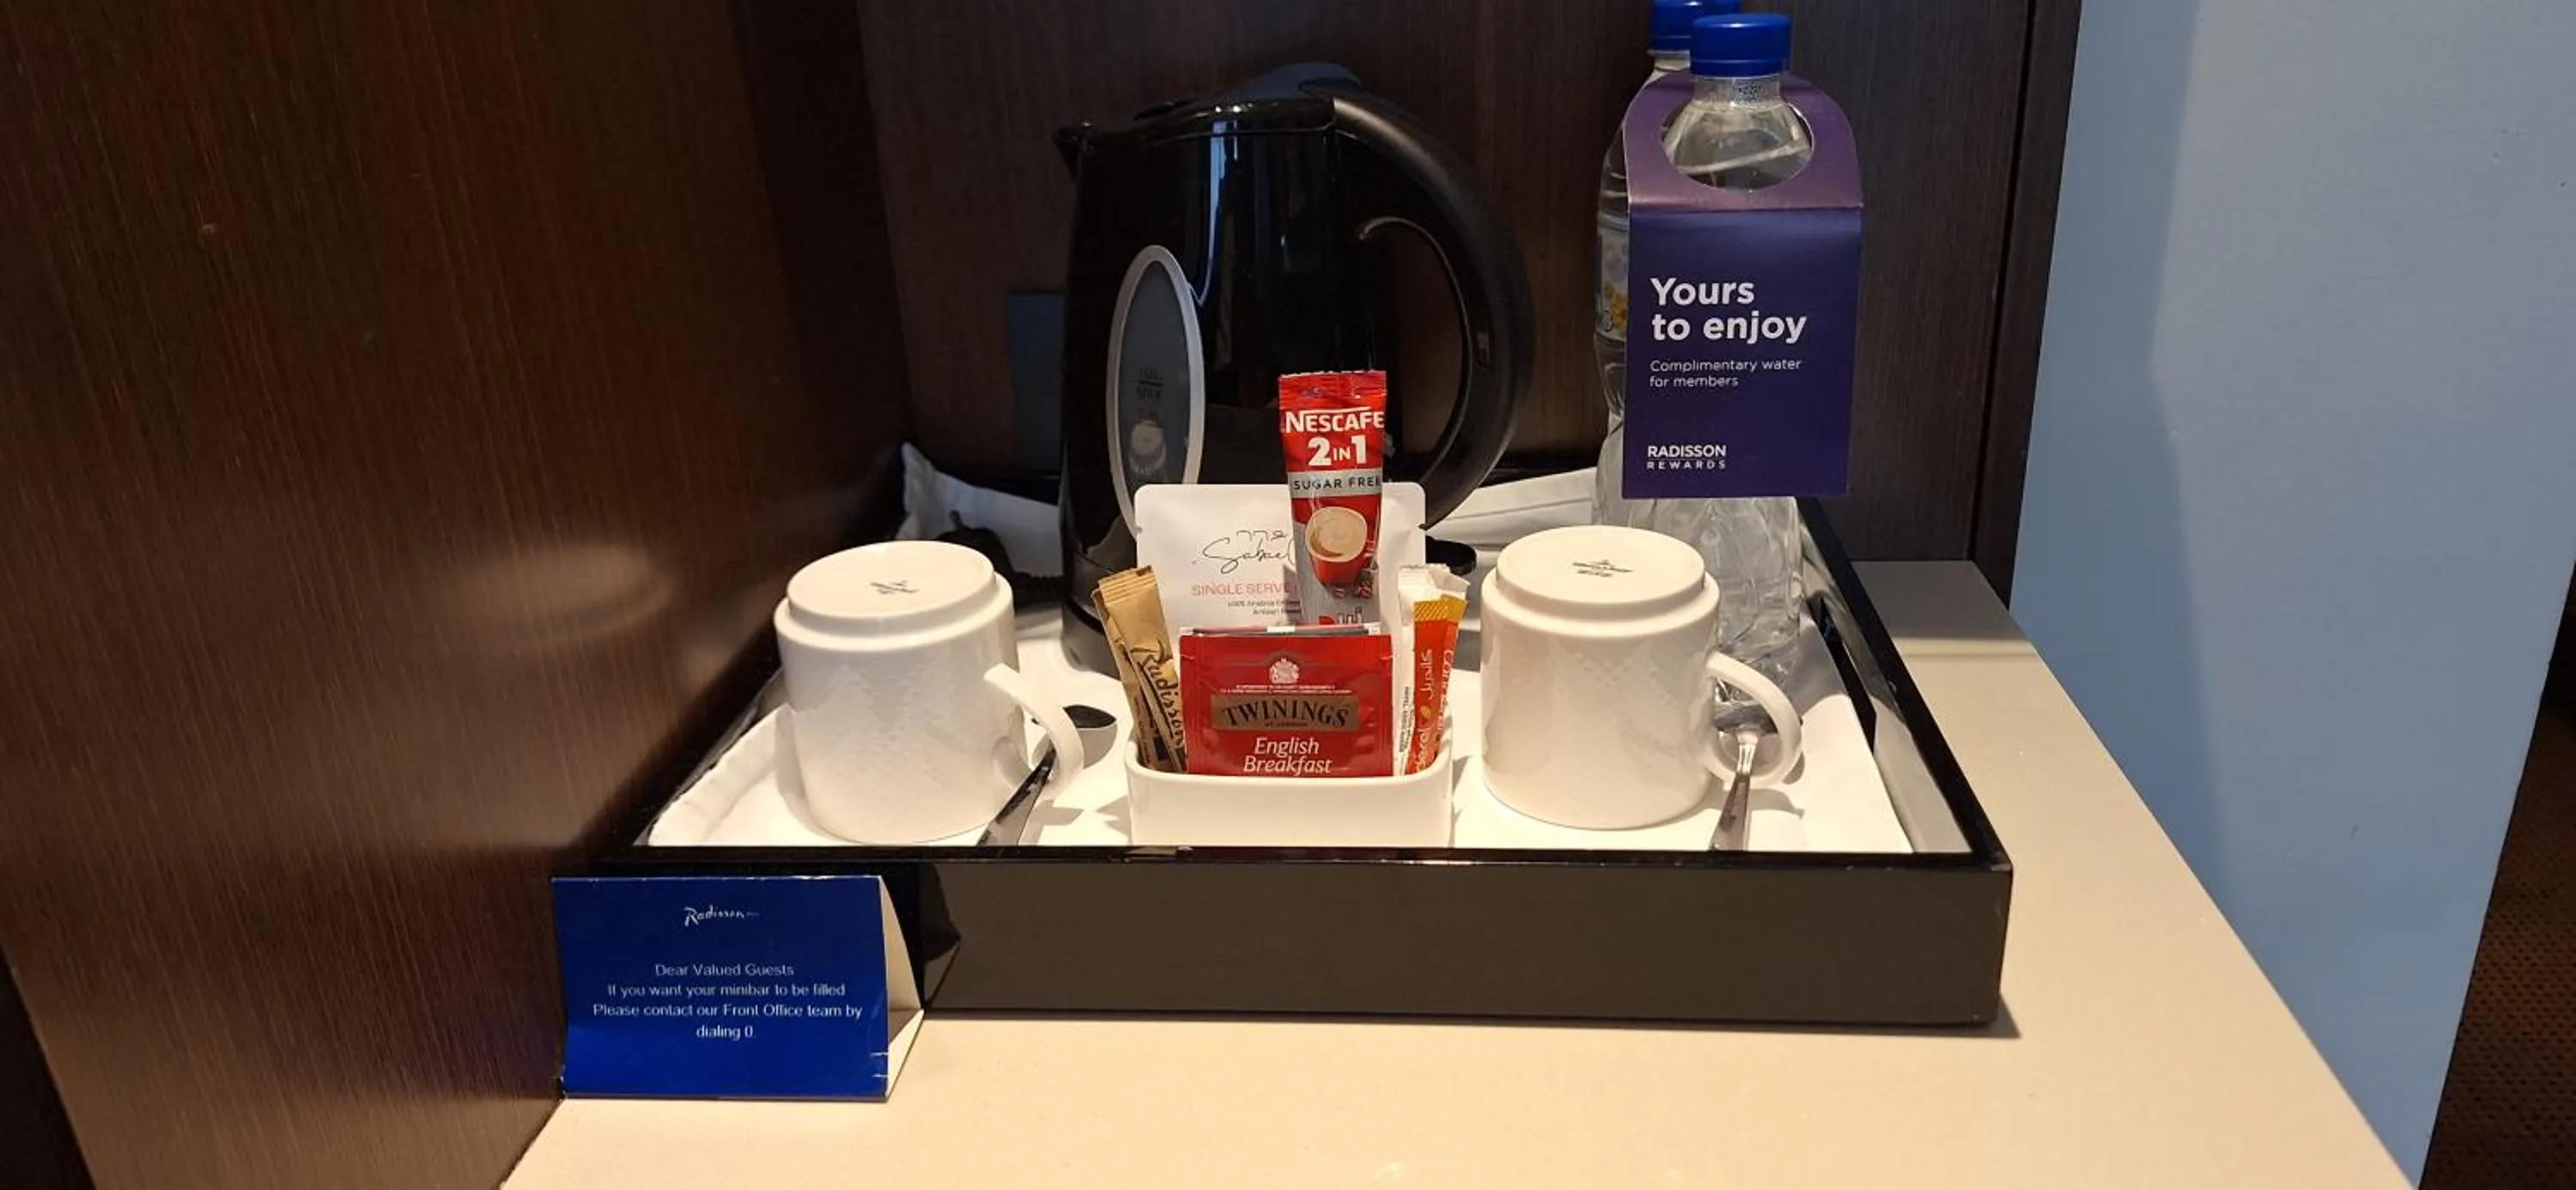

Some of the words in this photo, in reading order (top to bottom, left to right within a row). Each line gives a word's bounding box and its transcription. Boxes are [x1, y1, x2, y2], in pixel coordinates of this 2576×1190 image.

[1649, 278, 1755, 306] Yours
[1651, 313, 1691, 341] to
[1703, 310, 1807, 344] enjoy
[1649, 360, 1758, 373] Complimentary
[1762, 359, 1801, 370] water
[1649, 375, 1669, 387] for
[1674, 374, 1739, 387] members
[1648, 445, 1727, 458] RADISSON
[1646, 459, 1726, 471] REWARDS
[1294, 478, 1342, 491] SUGAR
[1192, 583, 1243, 597] SINGLE
[1131, 638, 1184, 749] Radisson
[1223, 700, 1350, 727] TWININGS
[1254, 737, 1320, 757] English
[1243, 755, 1333, 776] Breakfast
[684, 904, 745, 927] Radisson
[655, 963, 688, 976] Dear
[693, 963, 741, 976] Valued
[744, 963, 794, 976] Guests
[608, 984, 617, 996] If
[621, 987, 645, 999] you
[649, 985, 682, 996] want
[686, 987, 716, 999] your
[720, 983, 769, 996] minibar
[775, 985, 788, 996] to
[792, 984, 809, 996] be
[813, 983, 846, 996] filled
[593, 1004, 640, 1016] Please
[644, 1005, 693, 1016] contact
[696, 1006, 718, 1017] our
[723, 1004, 759, 1017] Front
[763, 1003, 803, 1017] Office
[807, 1005, 842, 1017] team
[846, 1004, 863, 1021] by
[696, 1024, 741, 1041] dialing
[744, 1024, 753, 1037] 0
